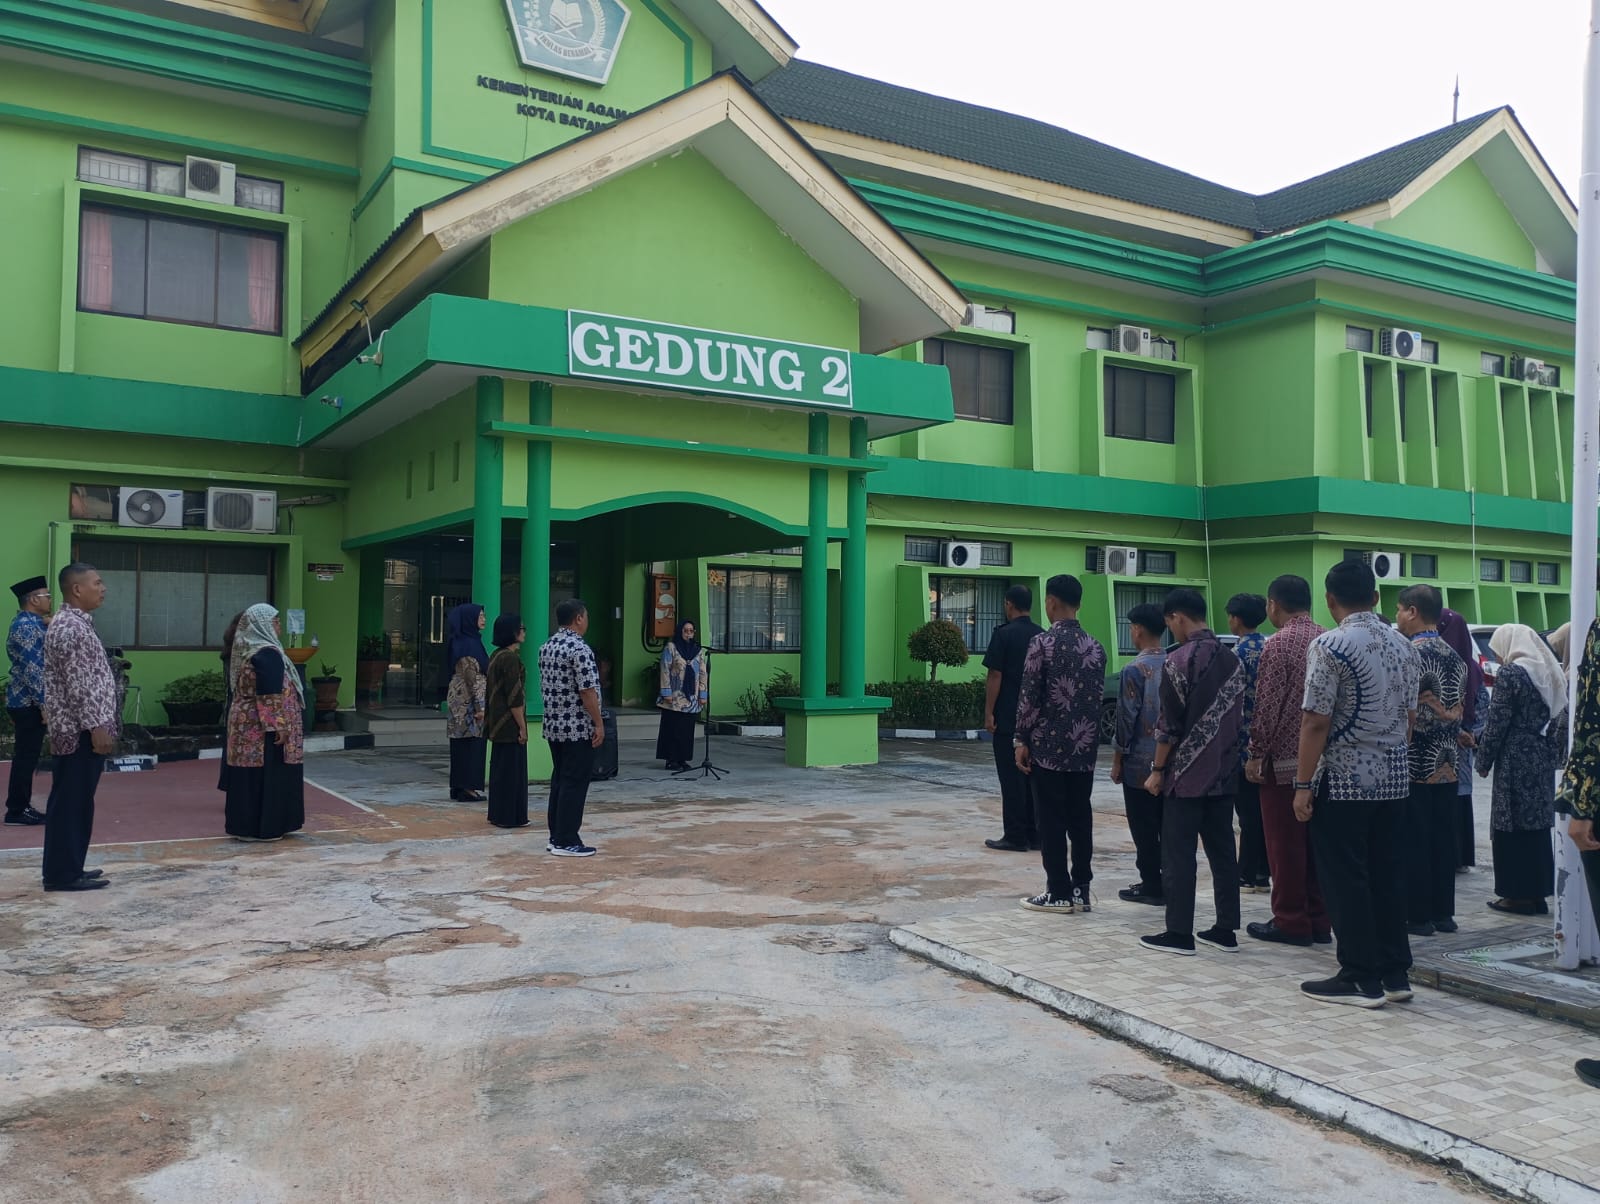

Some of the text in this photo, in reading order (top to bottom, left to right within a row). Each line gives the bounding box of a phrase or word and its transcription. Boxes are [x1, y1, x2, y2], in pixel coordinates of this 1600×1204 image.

[477, 75, 583, 110] KEMENTERIAN
[517, 103, 556, 124] KOTA
[572, 321, 849, 398] GEDUNG 2
